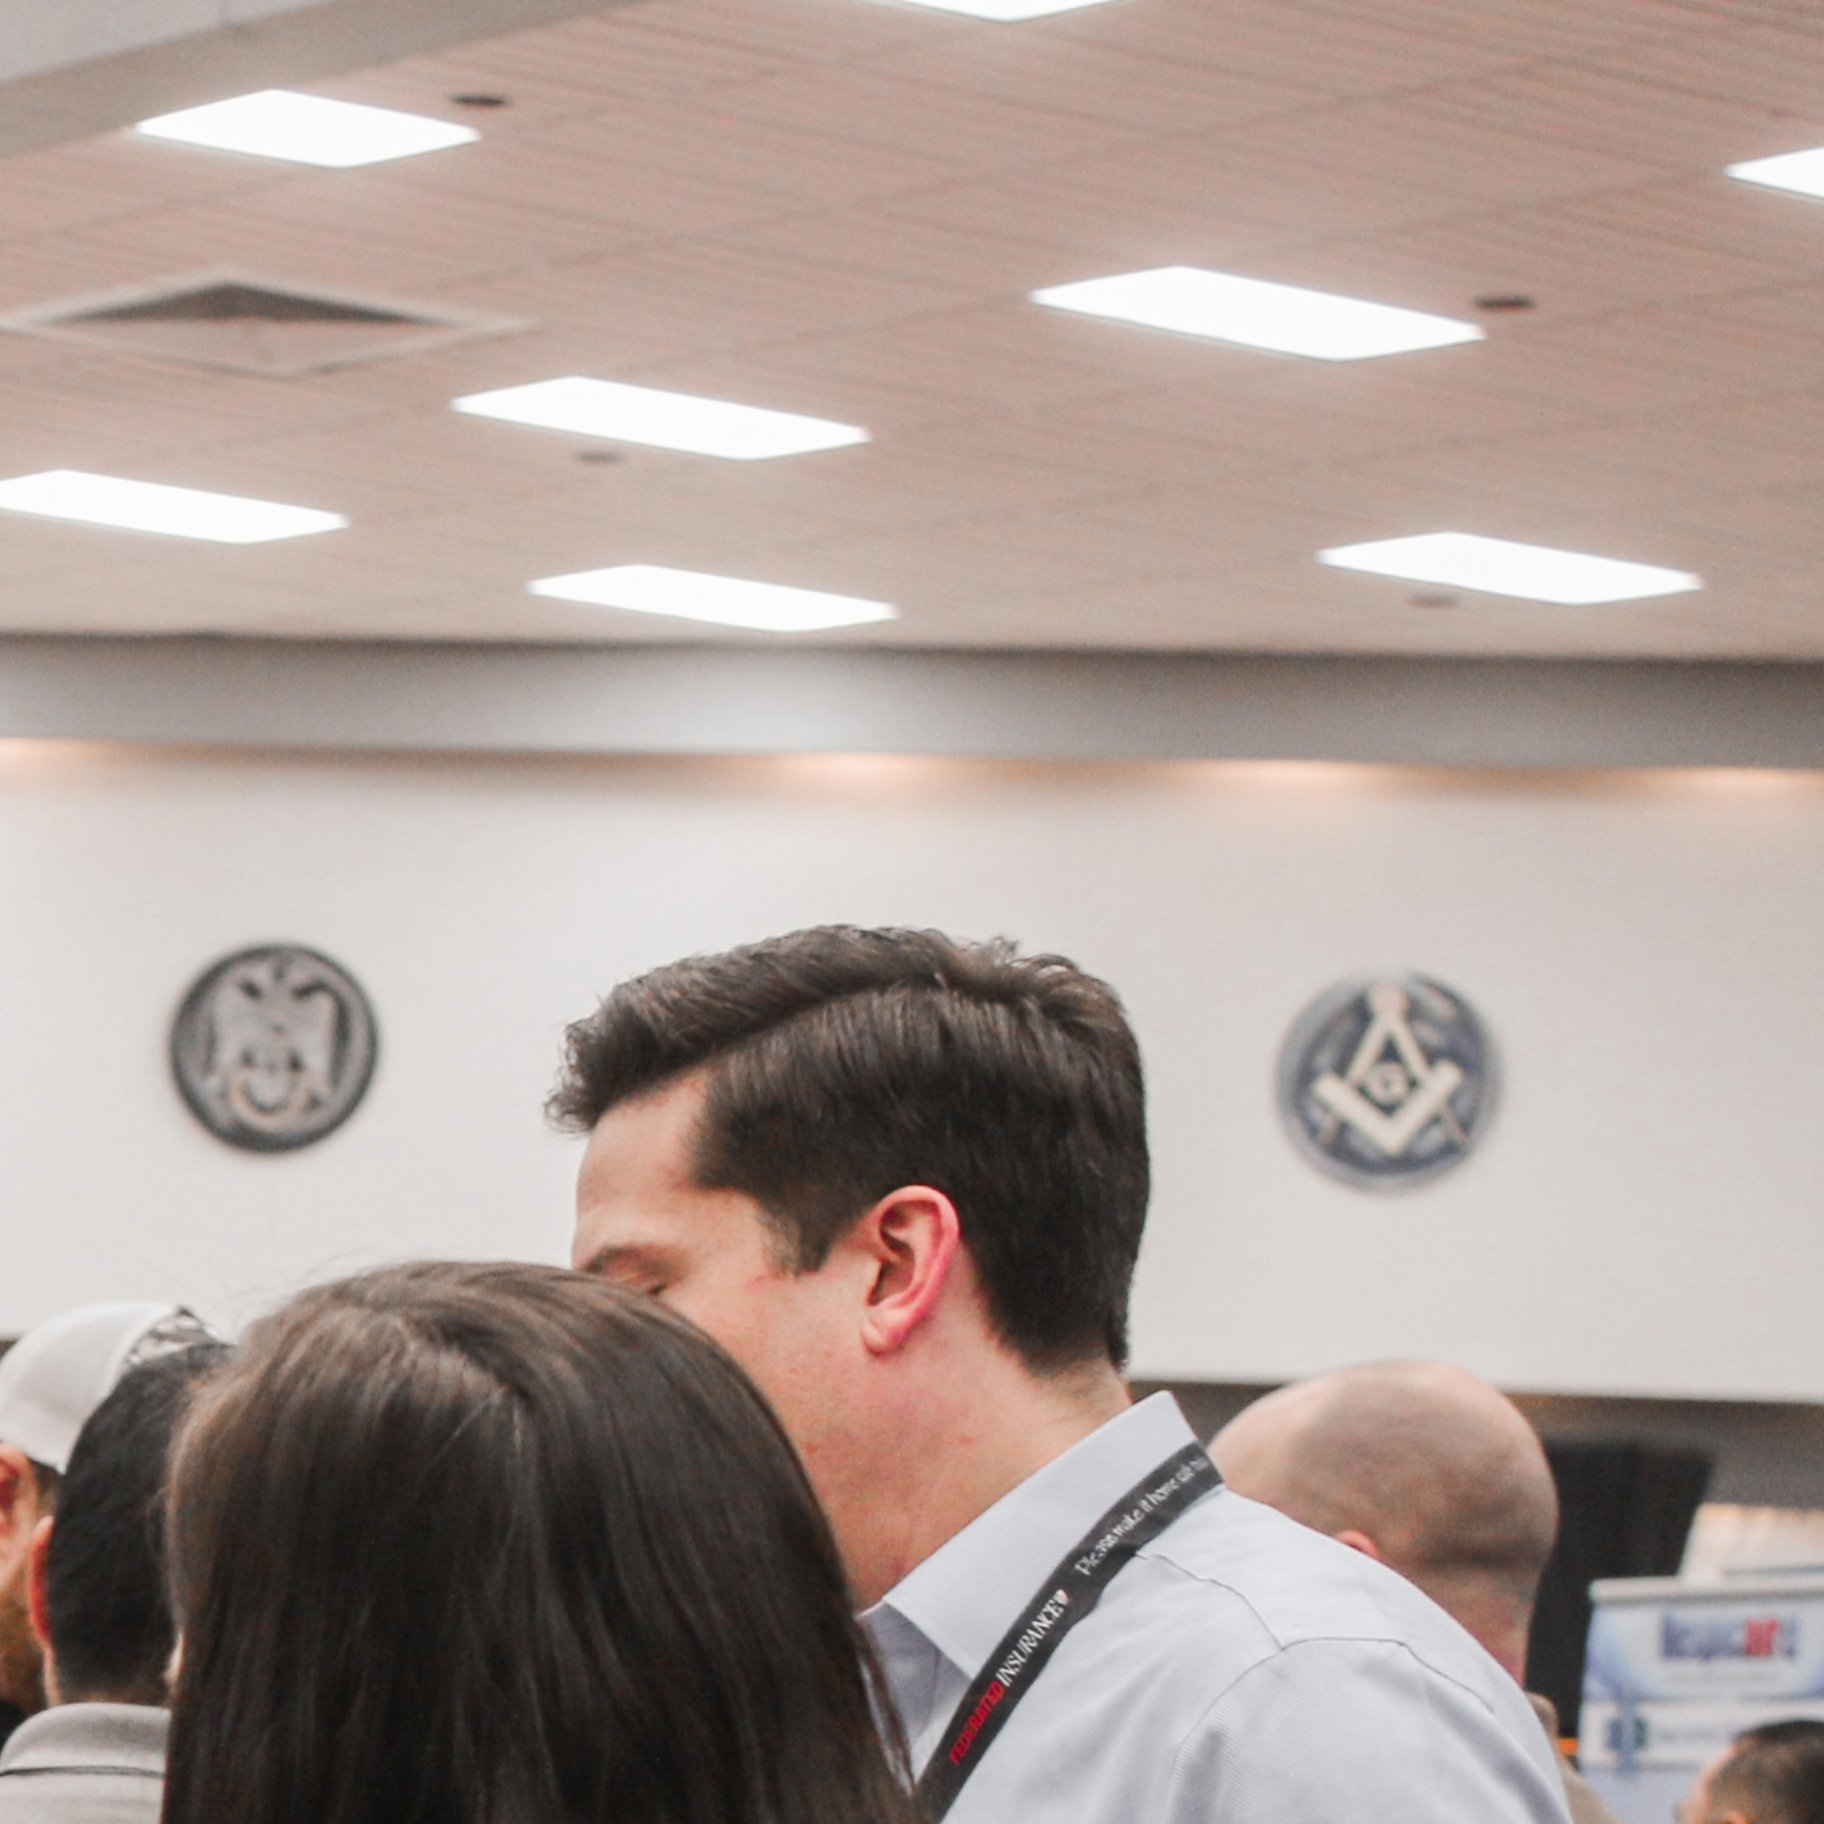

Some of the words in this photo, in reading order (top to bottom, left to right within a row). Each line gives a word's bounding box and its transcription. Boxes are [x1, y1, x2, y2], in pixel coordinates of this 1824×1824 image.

[1073, 1533, 1119, 1576] Please
[948, 1679, 1007, 1766] FEDERATED
[995, 1596, 1066, 1688] INSURANCE
